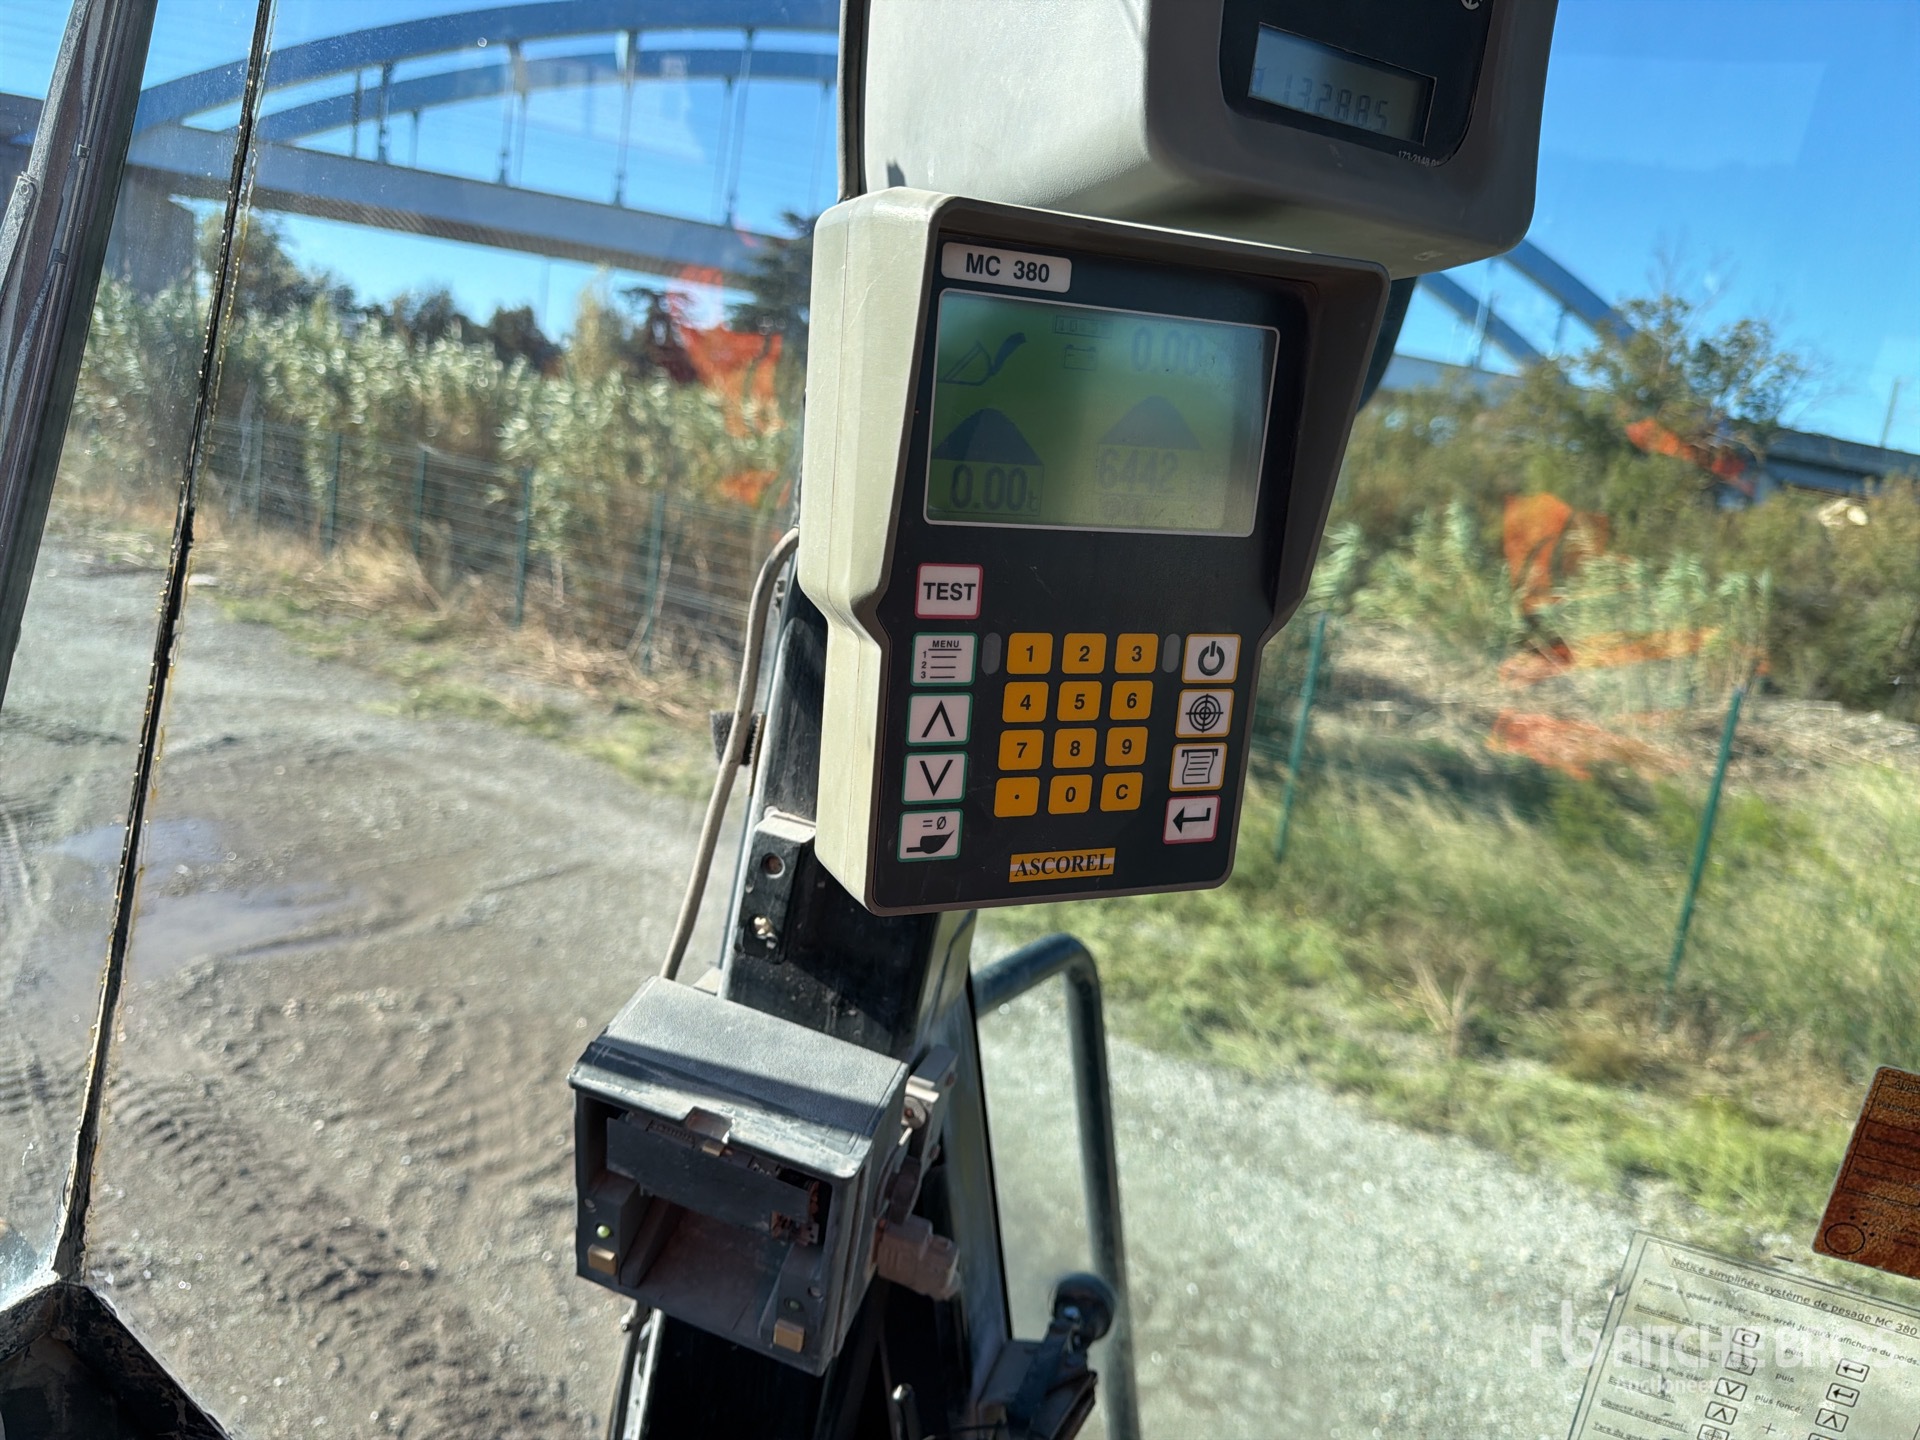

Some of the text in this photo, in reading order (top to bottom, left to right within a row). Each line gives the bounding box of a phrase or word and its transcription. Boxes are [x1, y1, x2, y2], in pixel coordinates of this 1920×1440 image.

[965, 252, 1050, 283] MC 380
[1098, 448, 1178, 493] 6442
[923, 582, 976, 601] TEST
[932, 639, 960, 648] MENU
[1026, 646, 1033, 662] 1
[1079, 646, 1089, 662] 2
[1132, 646, 1142, 662] 3
[1020, 694, 1031, 710] 4
[1074, 694, 1085, 710] 5
[1127, 693, 1137, 709] 6
[1017, 742, 1027, 758] 7
[1069, 741, 1080, 757] 8
[1121, 739, 1132, 755] 9
[1065, 787, 1076, 802] 0
[1116, 784, 1128, 800] C
[1014, 853, 1111, 876] ASCOREL
[1763, 1284, 1809, 1306] système
[1815, 1298, 1827, 1308] de
[1830, 1304, 1871, 1324] pesage
[1875, 1316, 1892, 1327] MC
[1896, 1323, 1917, 1335] 380
[1750, 1311, 1769, 1320] sans
[1880, 1348, 1891, 1356] du
[1776, 1372, 1794, 1383] puis
[1755, 1393, 1772, 1405] plus
